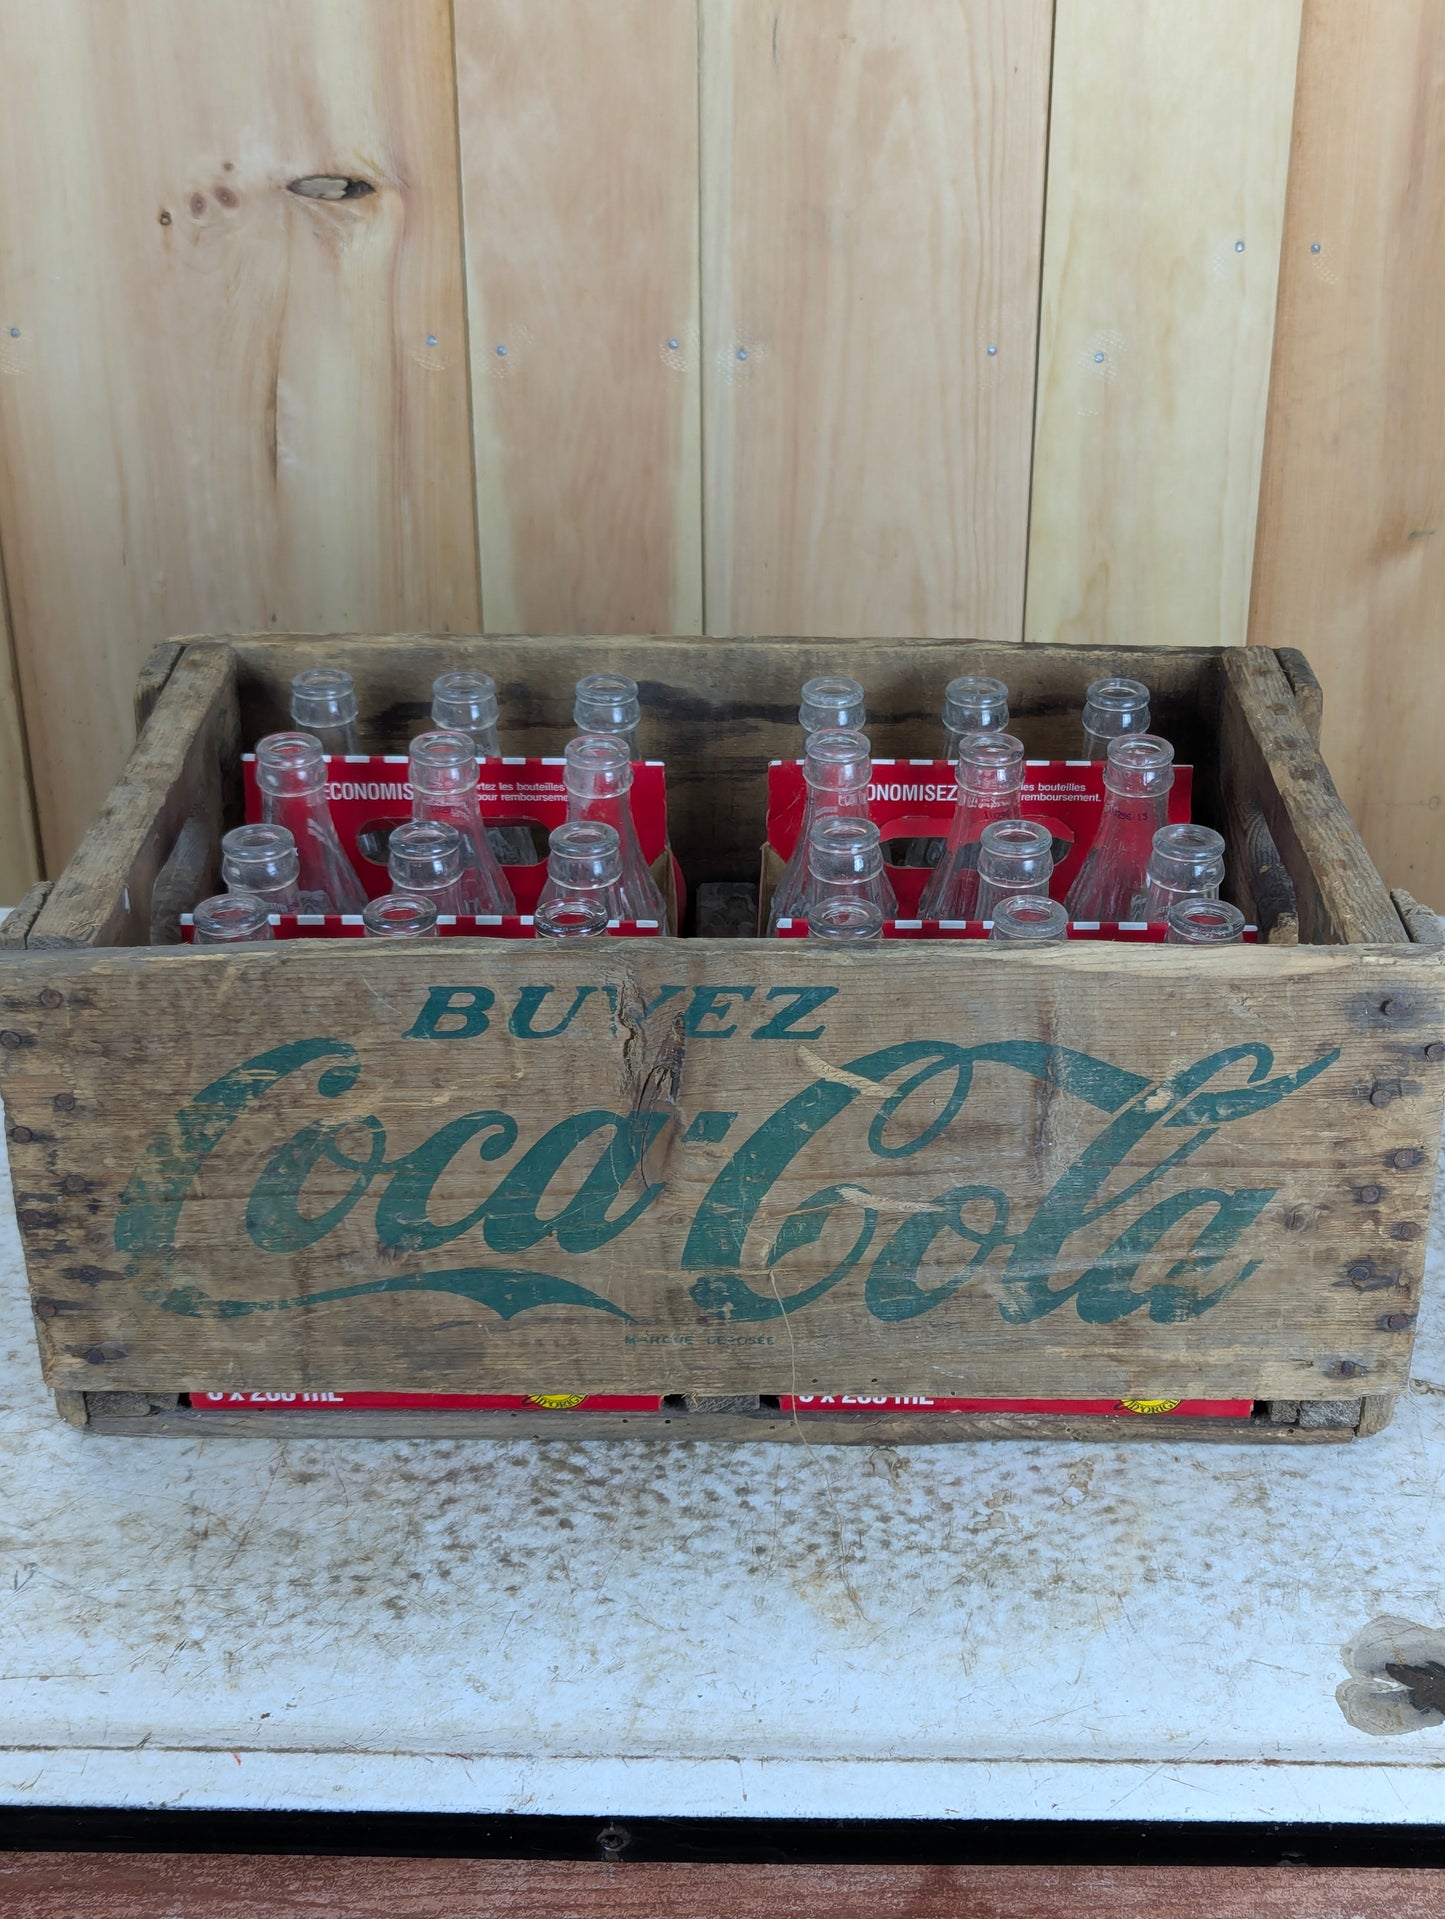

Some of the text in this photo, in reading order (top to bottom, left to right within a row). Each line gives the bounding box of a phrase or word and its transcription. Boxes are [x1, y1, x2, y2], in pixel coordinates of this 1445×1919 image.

[323, 782, 414, 801] ECONOMIS
[499, 782, 514, 791] les
[517, 782, 566, 792] bouteilles
[867, 784, 958, 801] ONOMISEZ
[1038, 782, 1086, 791] bouteilles
[501, 793, 568, 802] rembourseme
[402, 986, 839, 1040] BUYEZ
